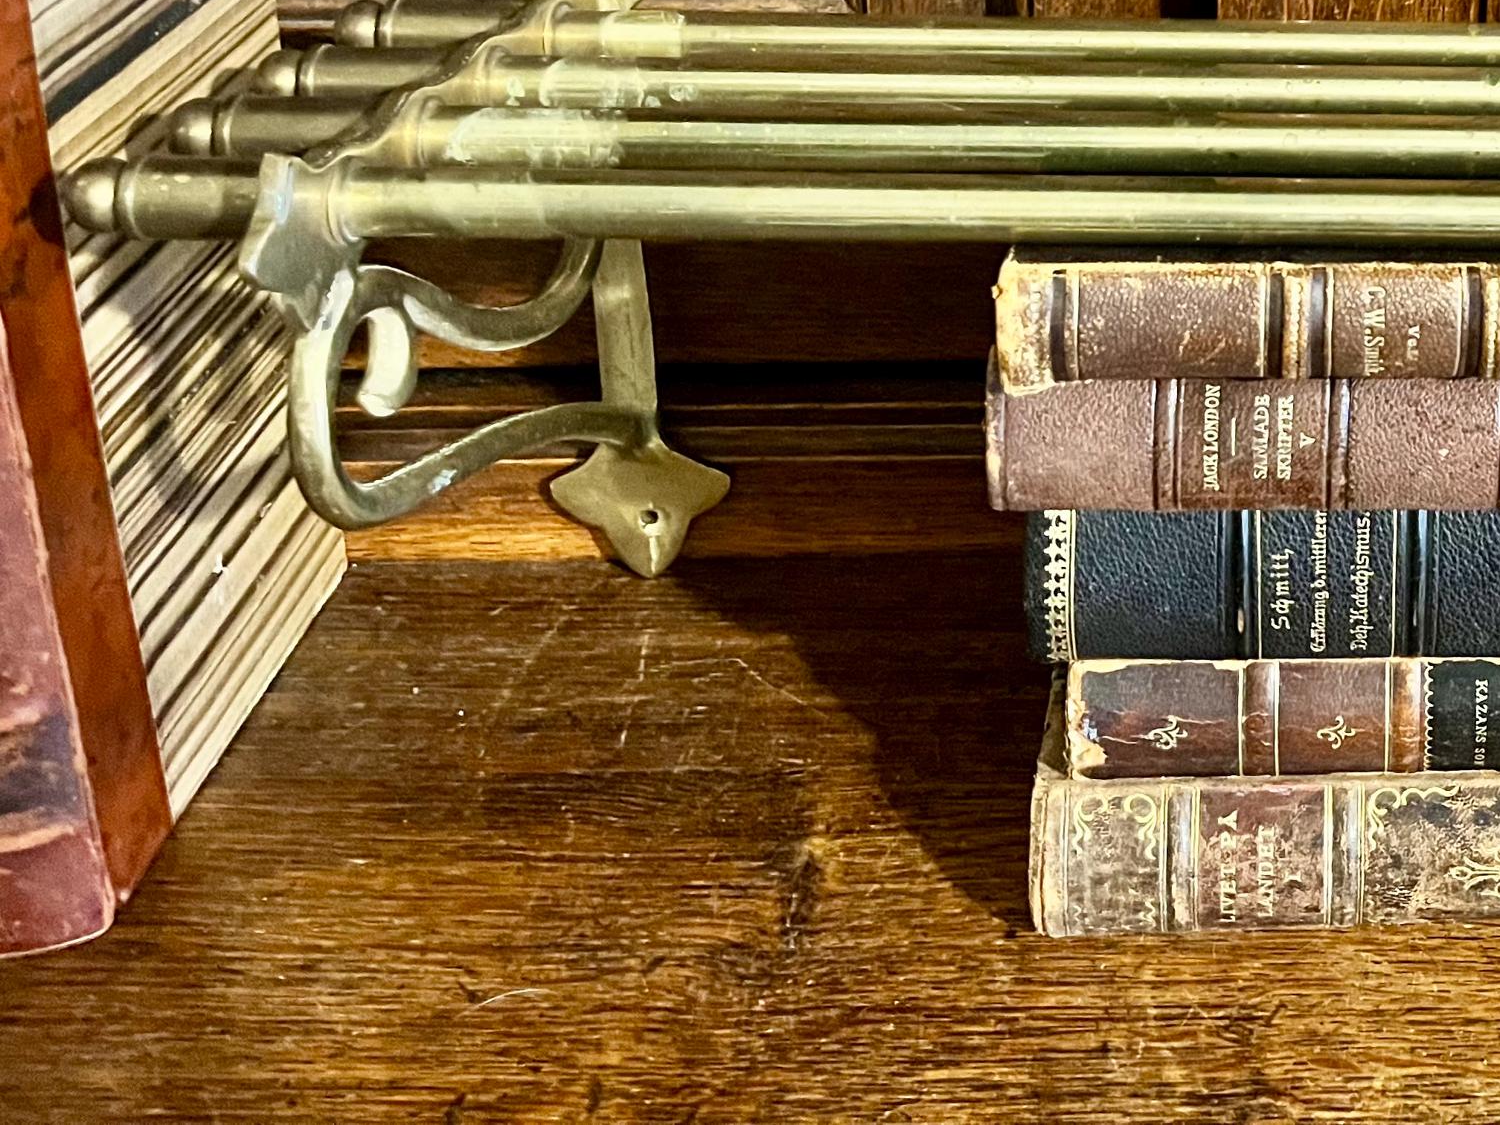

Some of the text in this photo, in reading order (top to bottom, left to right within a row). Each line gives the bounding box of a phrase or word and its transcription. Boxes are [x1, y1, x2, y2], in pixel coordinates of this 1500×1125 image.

[1203, 384, 1221, 491] JACK LONDON
[1251, 394, 1270, 479] SAMLADE
[1300, 432, 1316, 449] V
[1475, 679, 1488, 743] KAZANS
[1258, 825, 1275, 917] LANDET
